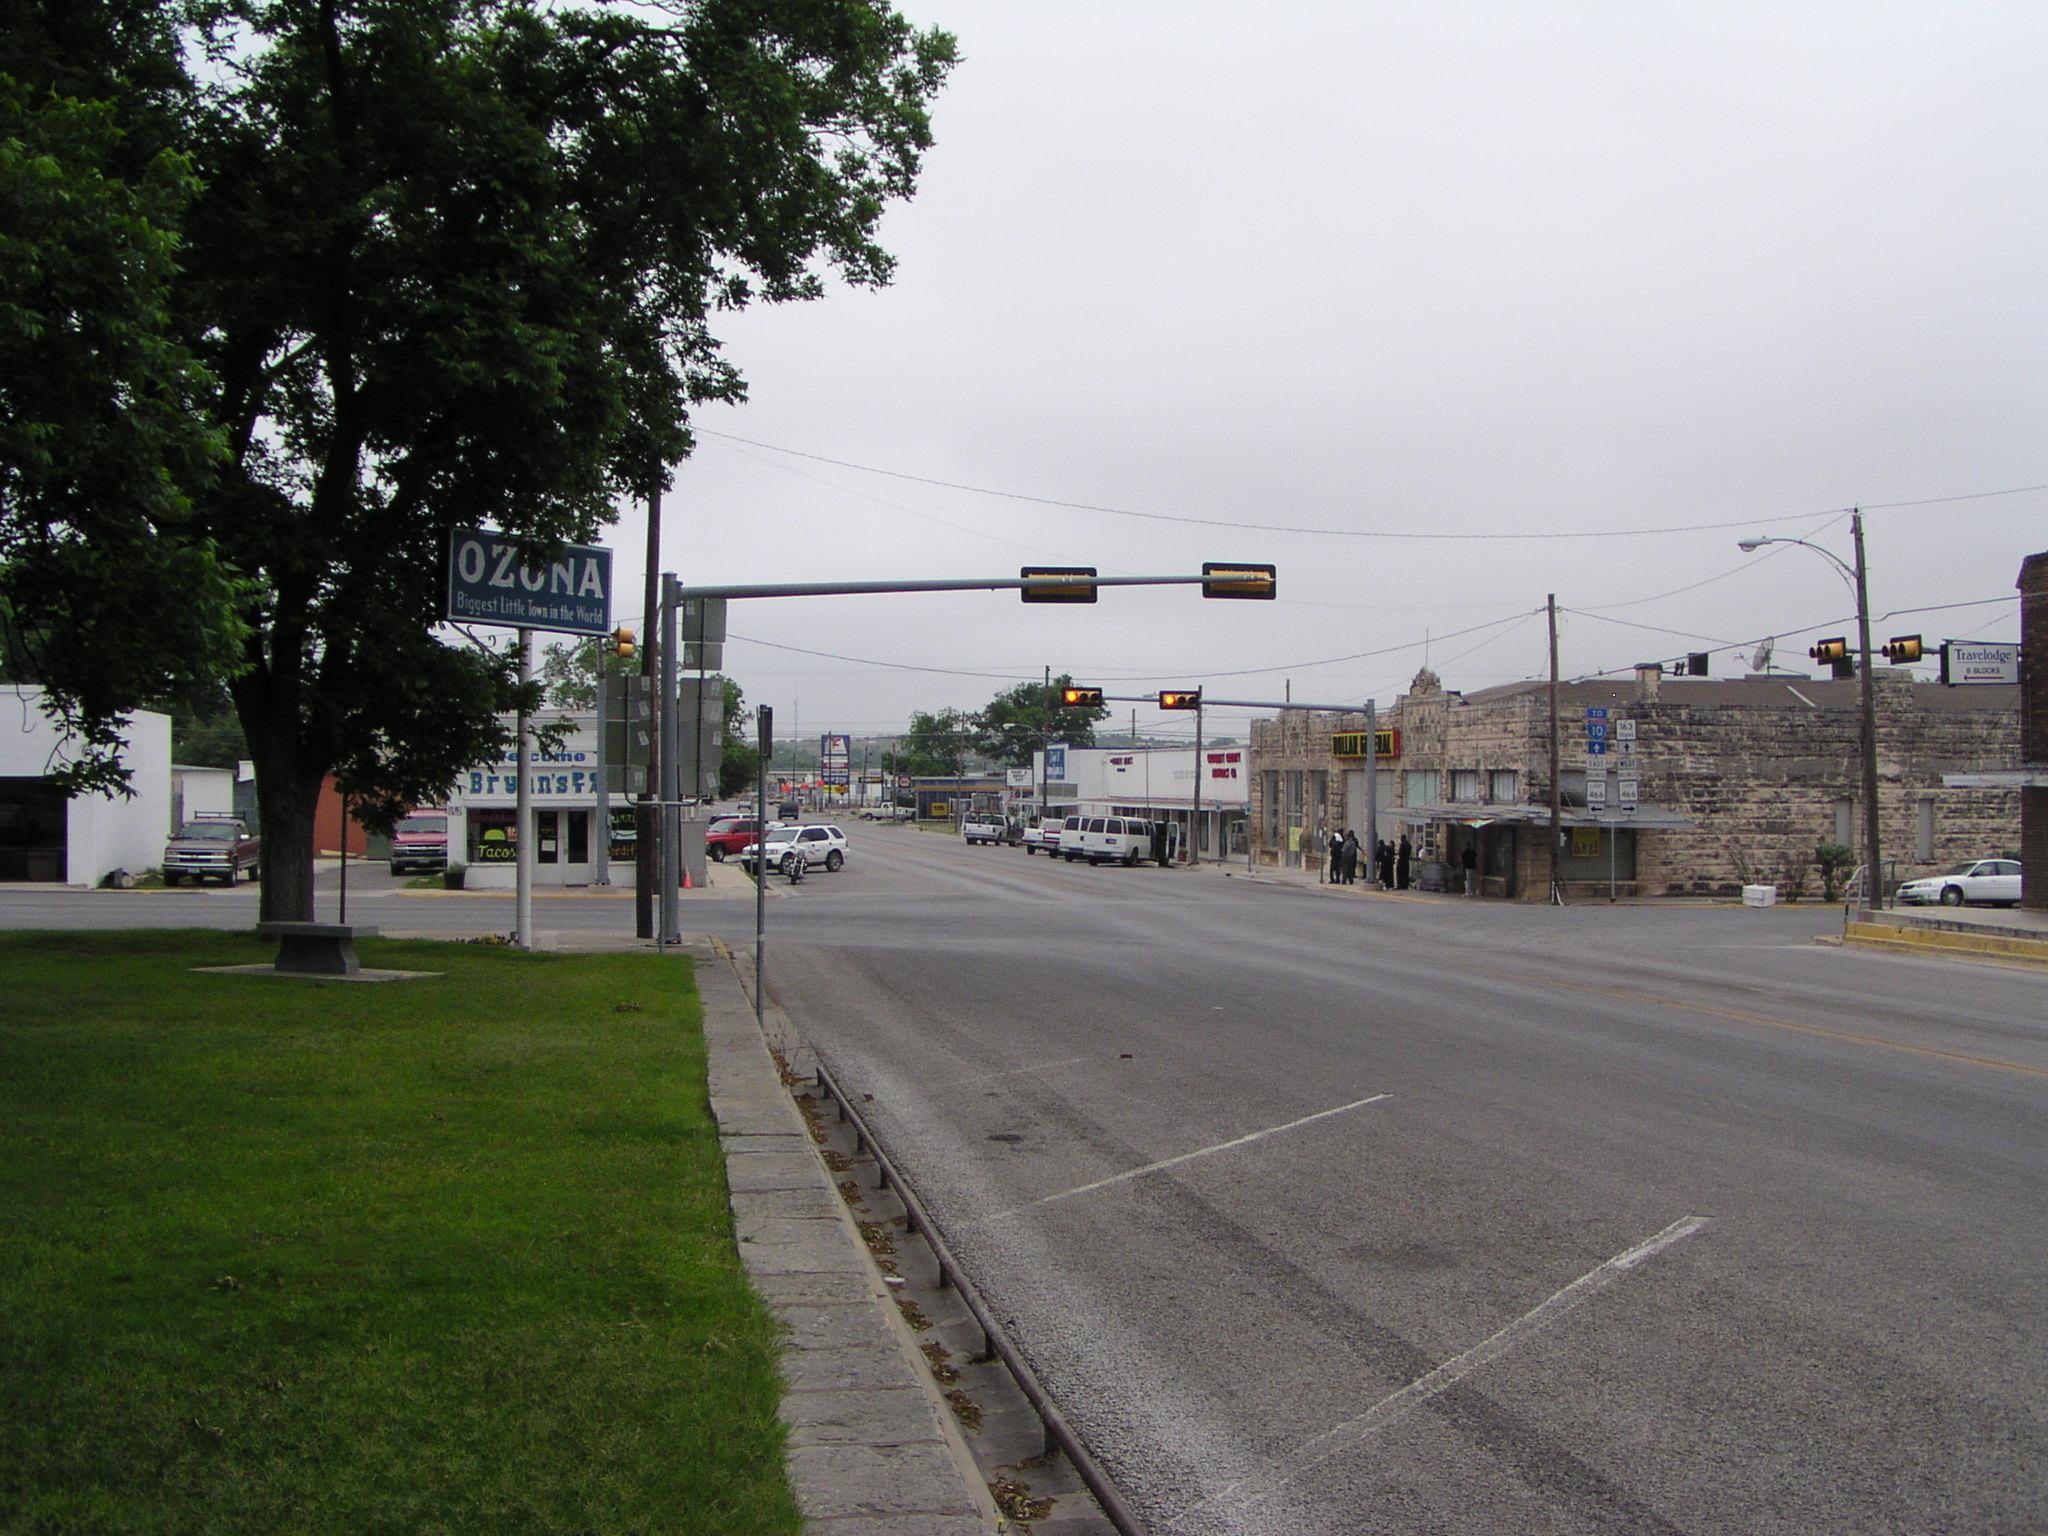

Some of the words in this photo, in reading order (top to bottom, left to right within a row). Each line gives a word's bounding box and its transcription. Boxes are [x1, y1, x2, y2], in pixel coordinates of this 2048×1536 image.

[456, 591, 498, 615] Biggest
[500, 595, 525, 616] Little
[528, 599, 548, 618] Town
[550, 603, 558, 620] in
[560, 604, 574, 621] the
[576, 605, 603, 624] World
[1954, 648, 2012, 664] Travelodge
[1591, 725, 1603, 736] 10
[470, 772, 567, 795] Bryn's
